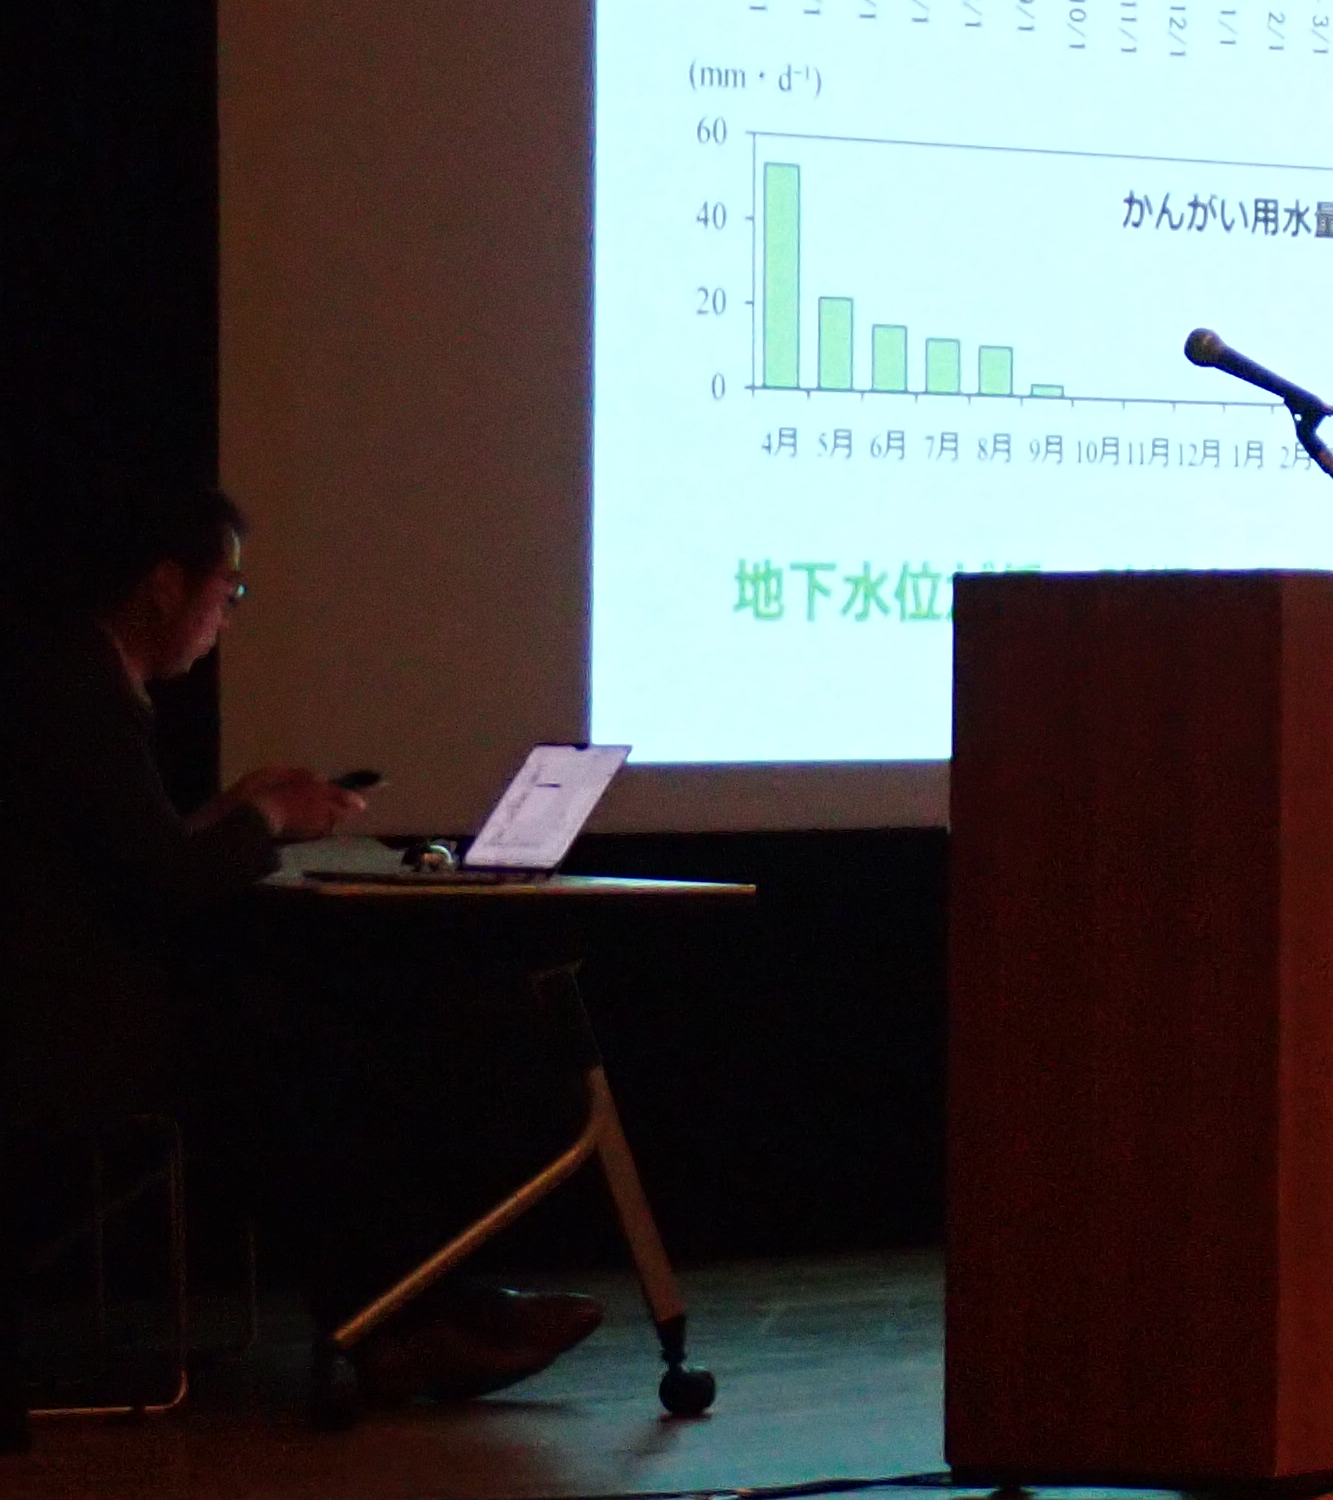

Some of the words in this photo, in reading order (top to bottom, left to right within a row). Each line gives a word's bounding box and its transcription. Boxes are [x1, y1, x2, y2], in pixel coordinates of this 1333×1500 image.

[1119, 2, 1138, 53] 11/1
[1168, 5, 1188, 57] 12/1
[1218, 9, 1238, 45] 1/1
[1267, 11, 1286, 51] 2/1
[1311, 15, 1330, 55] 3/1
[697, 116, 728, 145] 60
[695, 200, 727, 230] 40
[696, 286, 727, 316] 20
[711, 372, 726, 400] 0
[761, 426, 798, 458] 4月
[817, 428, 852, 460] 5月
[870, 430, 905, 461] 6月
[925, 432, 959, 462] 7月
[977, 433, 1012, 464] 8月
[1029, 435, 1064, 465] 9月
[1077, 436, 1120, 466] 10月
[1128, 437, 1170, 468] 11月
[1178, 439, 1220, 468] 12月
[1234, 440, 1264, 469] 1月
[733, 558, 953, 623] 地下水位
